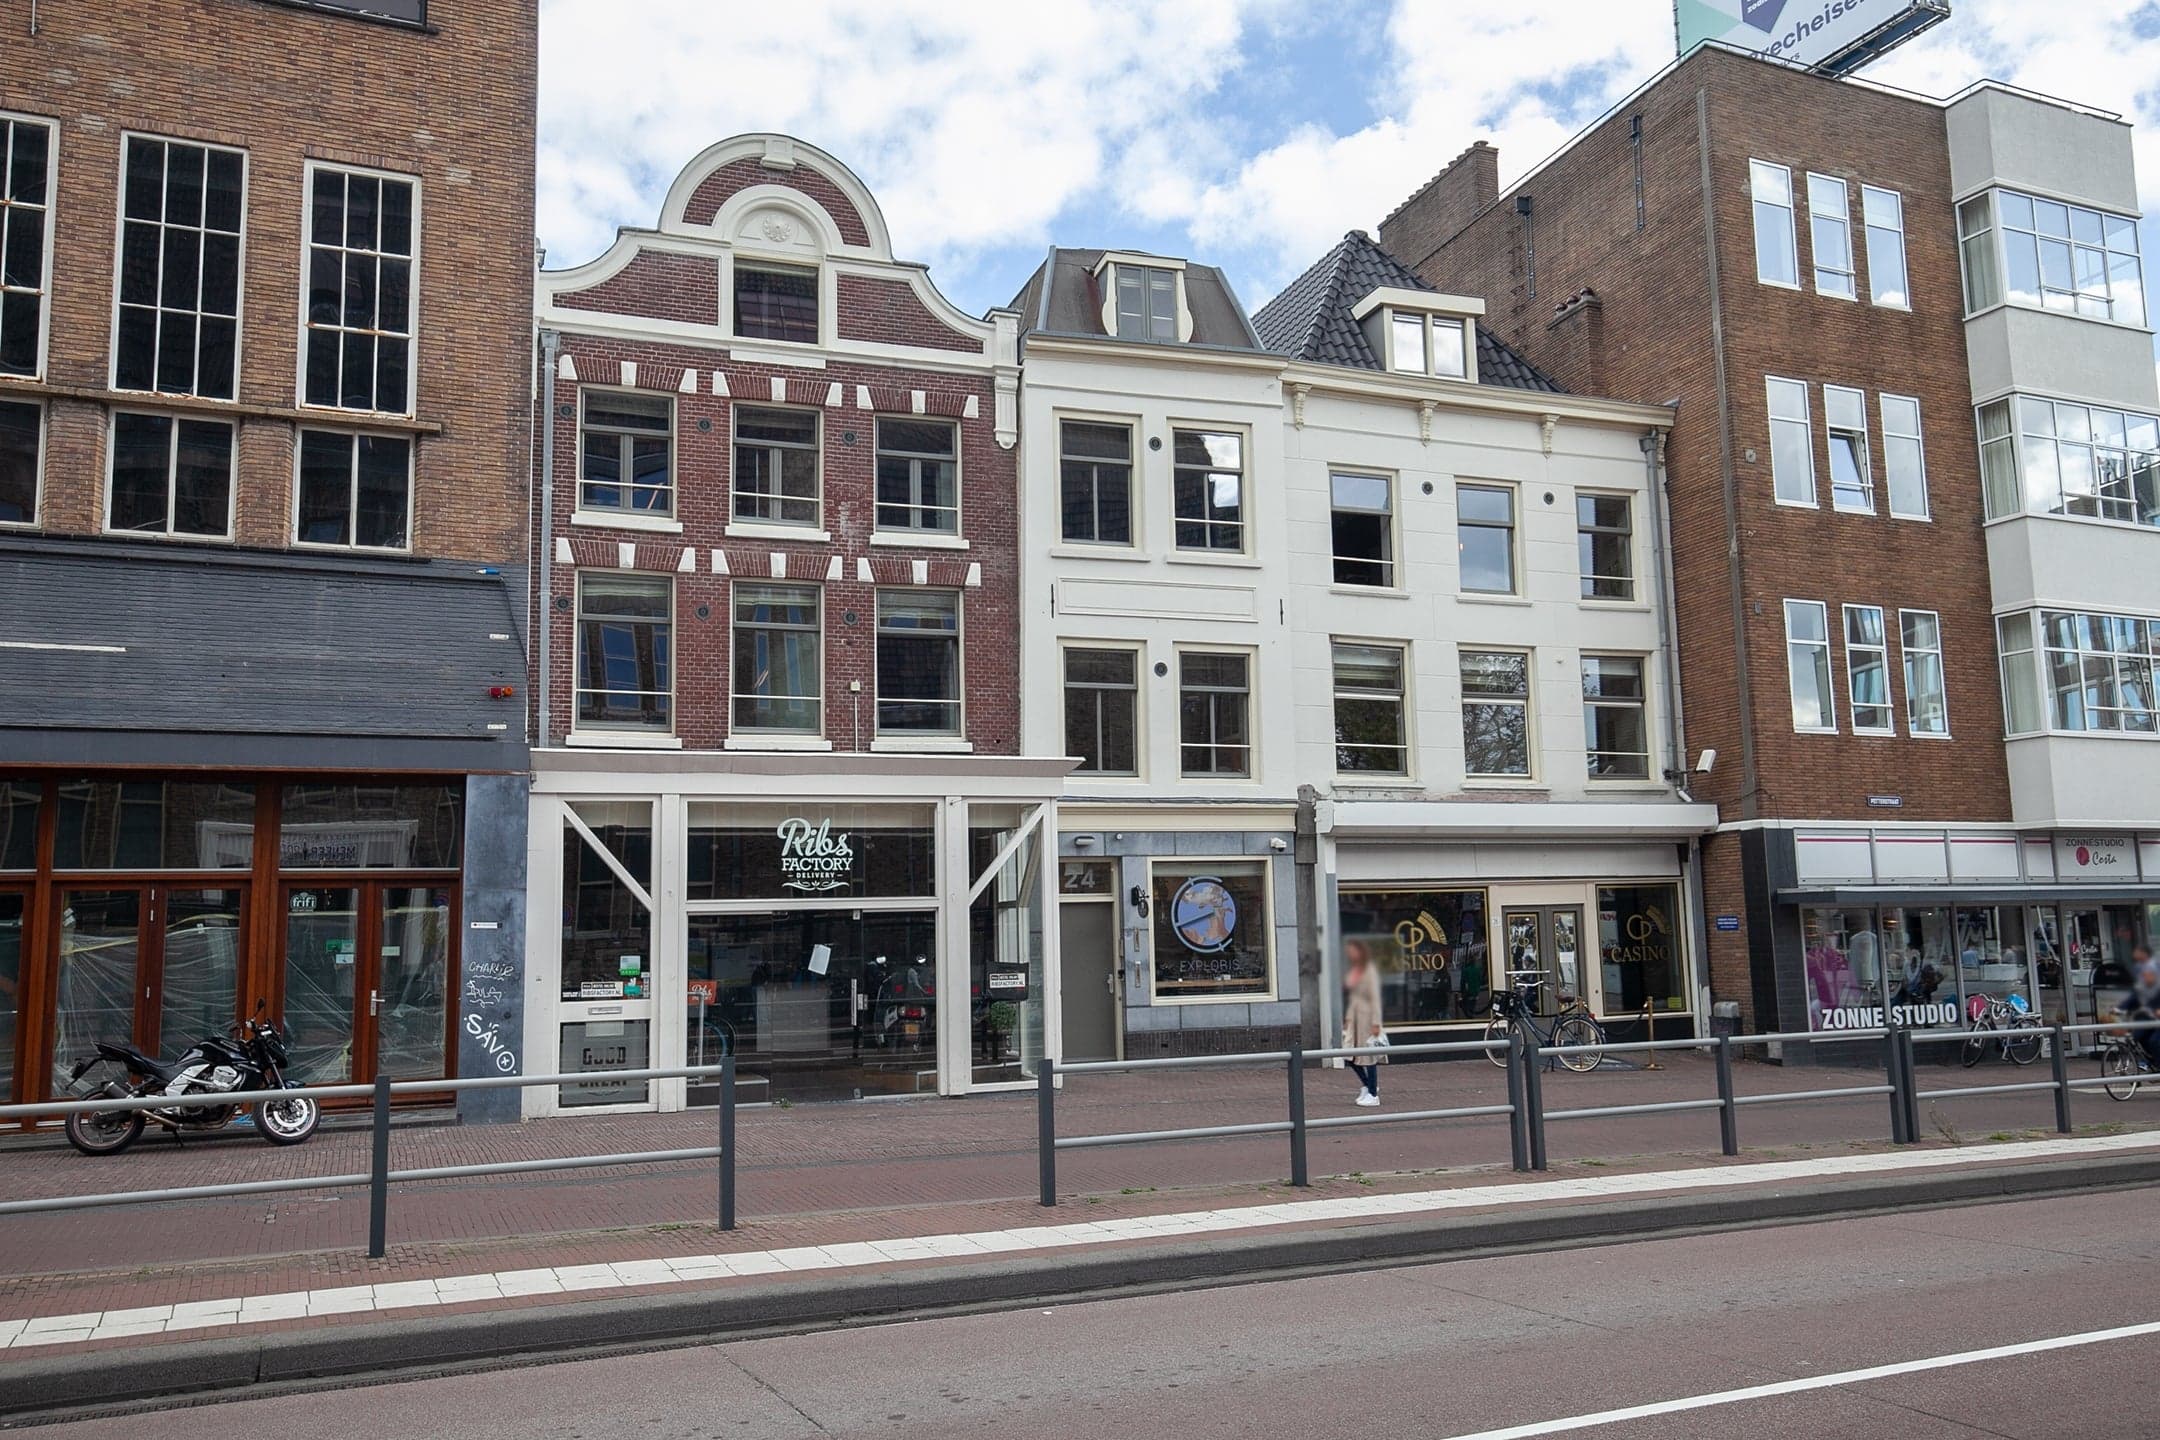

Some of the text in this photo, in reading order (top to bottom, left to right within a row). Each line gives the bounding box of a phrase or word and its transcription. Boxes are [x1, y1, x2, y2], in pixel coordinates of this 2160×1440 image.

[777, 817, 853, 857] Ribs
[2065, 838, 2125, 847] ZONNESTUDIO
[781, 858, 854, 871] FACTORY
[1064, 869, 1096, 888] 24
[1392, 953, 1445, 971] ASINO
[1611, 945, 1672, 963] CASINO
[1180, 960, 1241, 972] EXPLORIS
[1822, 1003, 1957, 1029] ZONNE STUDIO
